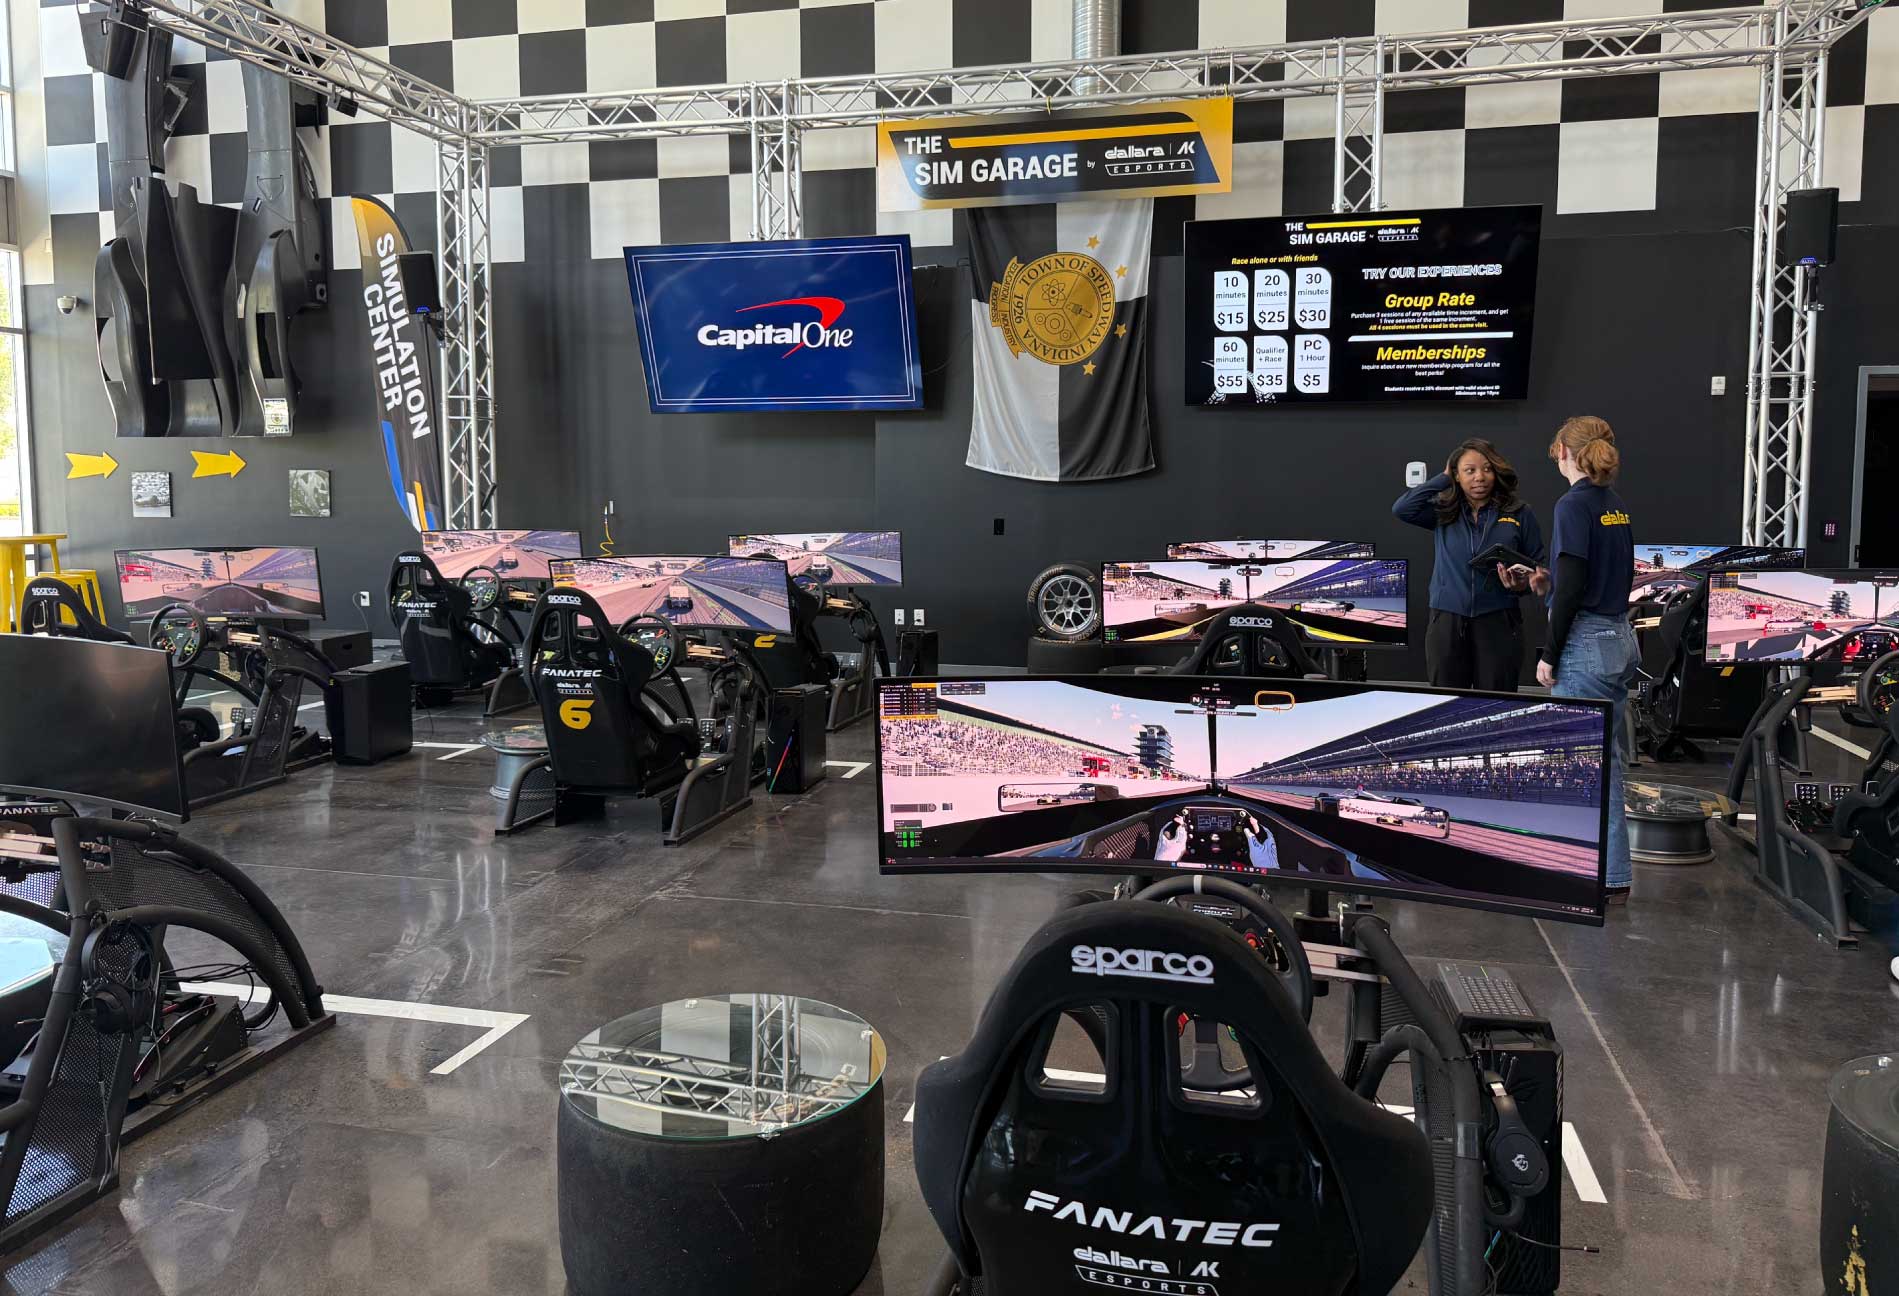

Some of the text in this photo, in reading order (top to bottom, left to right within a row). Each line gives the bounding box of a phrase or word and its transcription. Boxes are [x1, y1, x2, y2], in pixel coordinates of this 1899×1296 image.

[904, 136, 942, 154] THE
[1104, 145, 1165, 160] dallara
[915, 153, 1096, 186] SIM GARAGE by
[1114, 162, 1186, 174] ESPORTS
[1285, 222, 1304, 232] THE
[1290, 233, 1312, 245] SIM
[1316, 231, 1366, 244] GARAGE
[1069, 258, 1090, 272] OF
[1294, 254, 1318, 262] friends
[1020, 258, 1066, 287] TOWN
[1306, 273, 1321, 284] 30
[1362, 264, 1502, 279] TRY OUR EXPERIENCES
[1002, 263, 1018, 304] EDUCATION
[1224, 276, 1239, 287] 10
[1264, 275, 1280, 286] 20
[1385, 292, 1475, 310] Group Rate
[1013, 294, 1025, 324] 1926
[1299, 308, 1326, 323] $30
[1217, 312, 1244, 326] $15
[1259, 310, 1285, 324] $25
[376, 232, 430, 439] SIMULATION
[1000, 312, 1017, 347] INDUSTRY
[364, 284, 404, 412] CENTER
[1024, 329, 1086, 360] INDIANA
[1223, 342, 1238, 352] 60
[1304, 340, 1322, 350] PC
[1376, 345, 1486, 362] Memberships
[1217, 375, 1243, 388] $55
[1257, 374, 1283, 387] $35
[1303, 373, 1321, 387] $5
[548, 595, 581, 604] sparco
[1230, 616, 1272, 626] sparco
[542, 668, 602, 677] FANATEC
[560, 699, 594, 730] 6
[0, 806, 58, 814] ANATEC
[1071, 944, 1214, 979] sparco
[1024, 1190, 1280, 1248] FANATEC
[1074, 1246, 1170, 1274] dallara
[1089, 1271, 1206, 1294] ESPORTS
